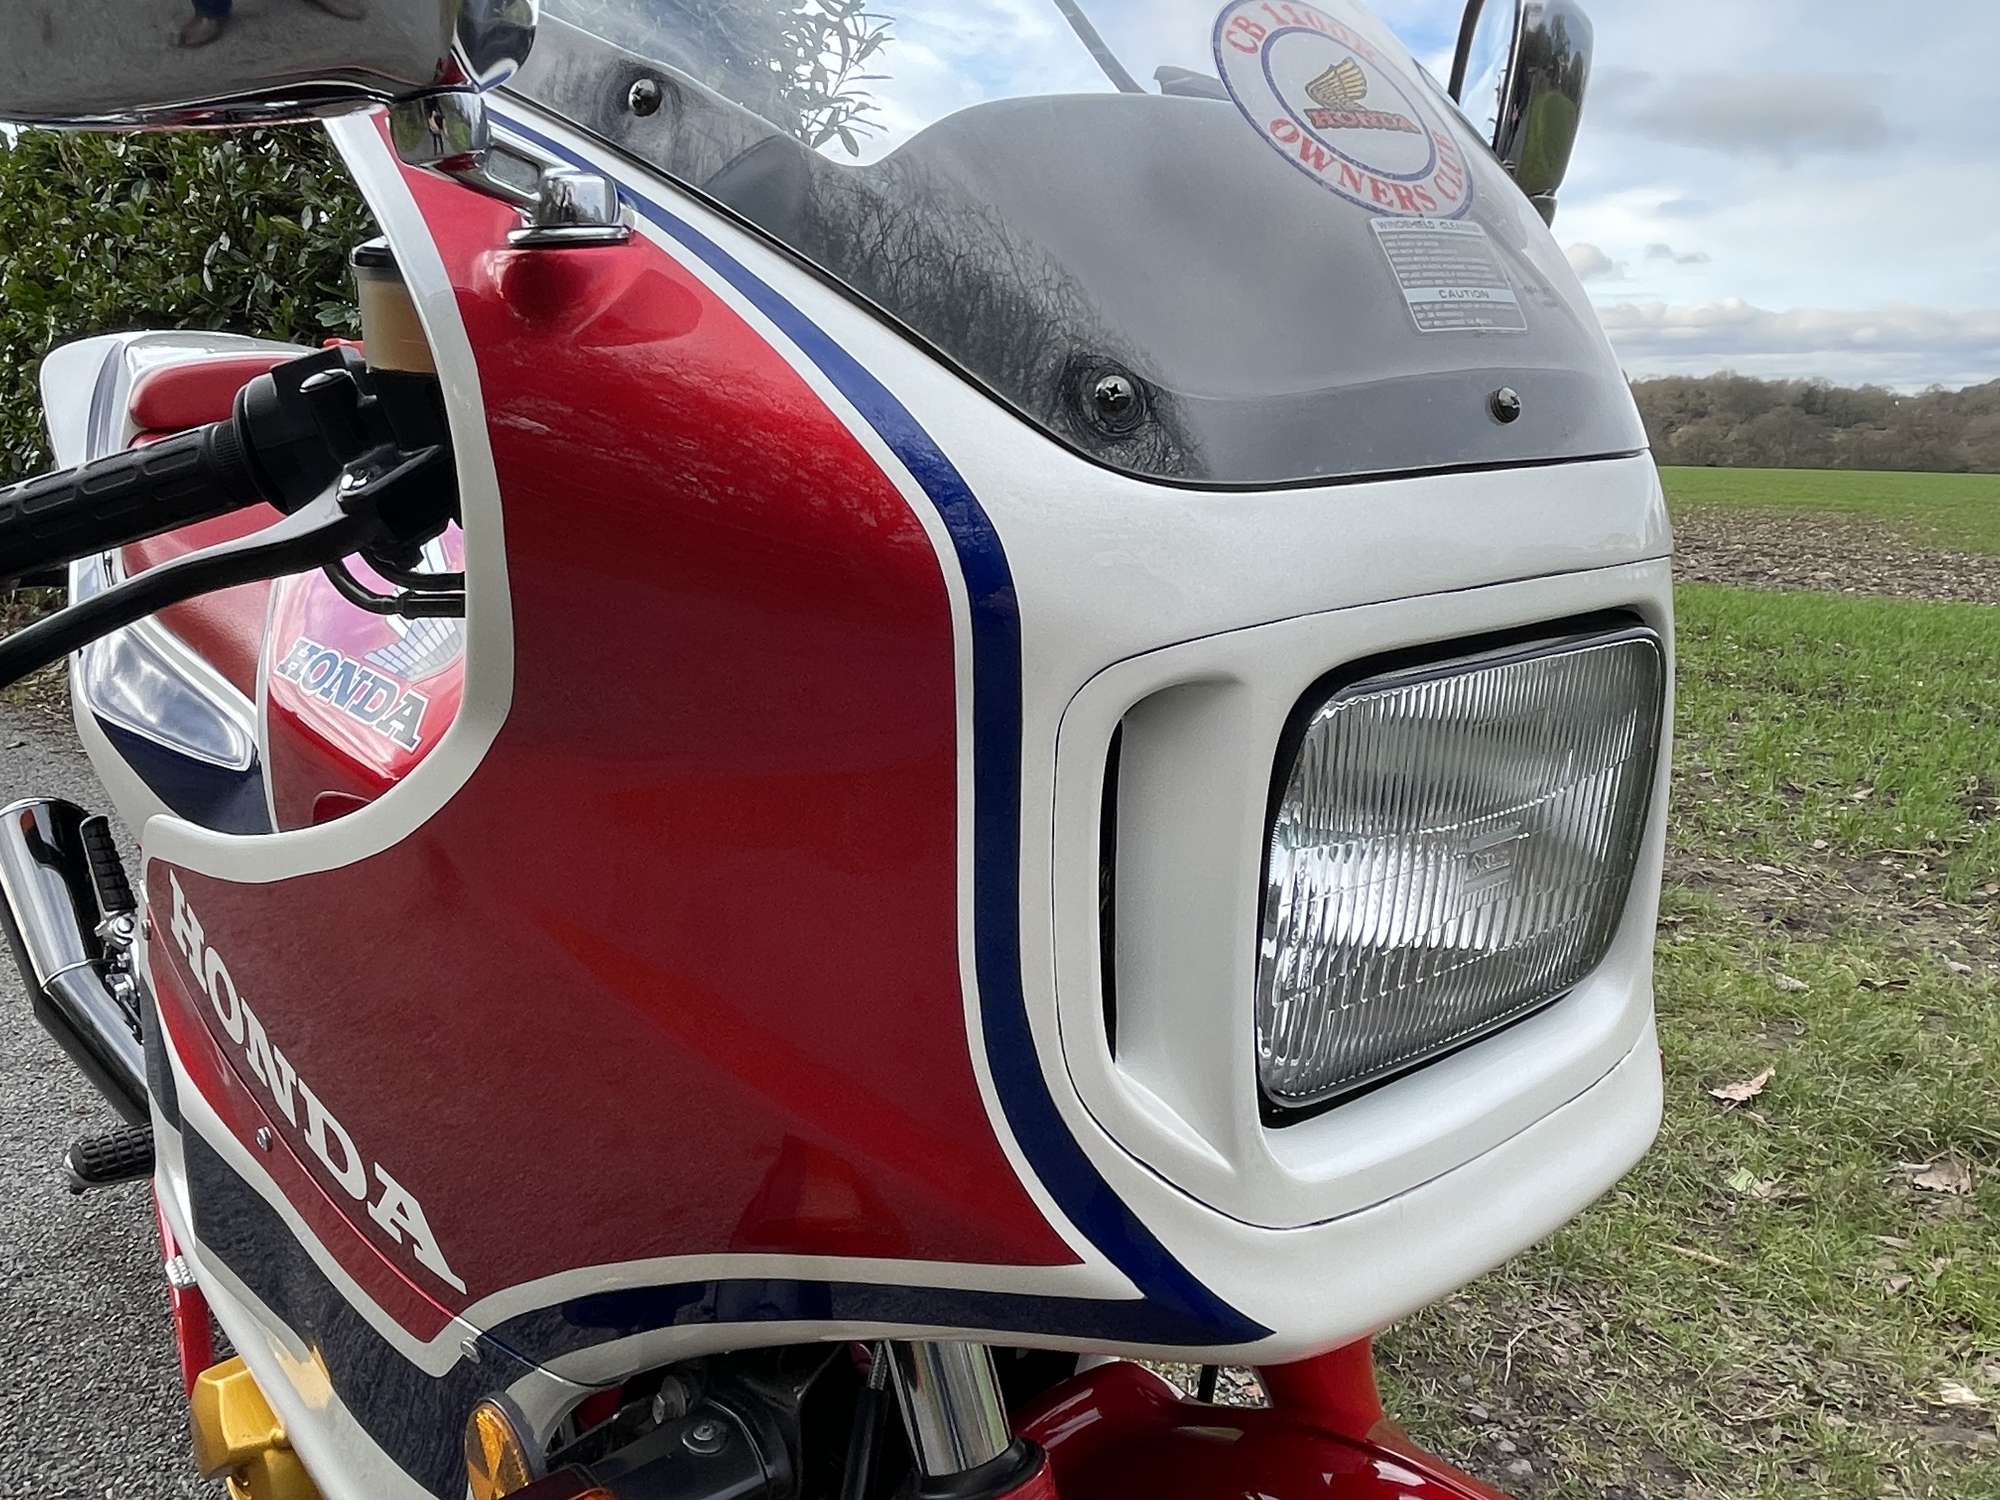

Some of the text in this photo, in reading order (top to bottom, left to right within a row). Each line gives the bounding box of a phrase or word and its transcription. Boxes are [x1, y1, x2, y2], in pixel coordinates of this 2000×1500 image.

[1225, 15, 1266, 54] CB
[1269, 118, 1438, 212] OWNERS
[1438, 289, 1490, 299] CAUTION
[274, 637, 428, 752] HONDA
[168, 869, 468, 1296] HONDA
